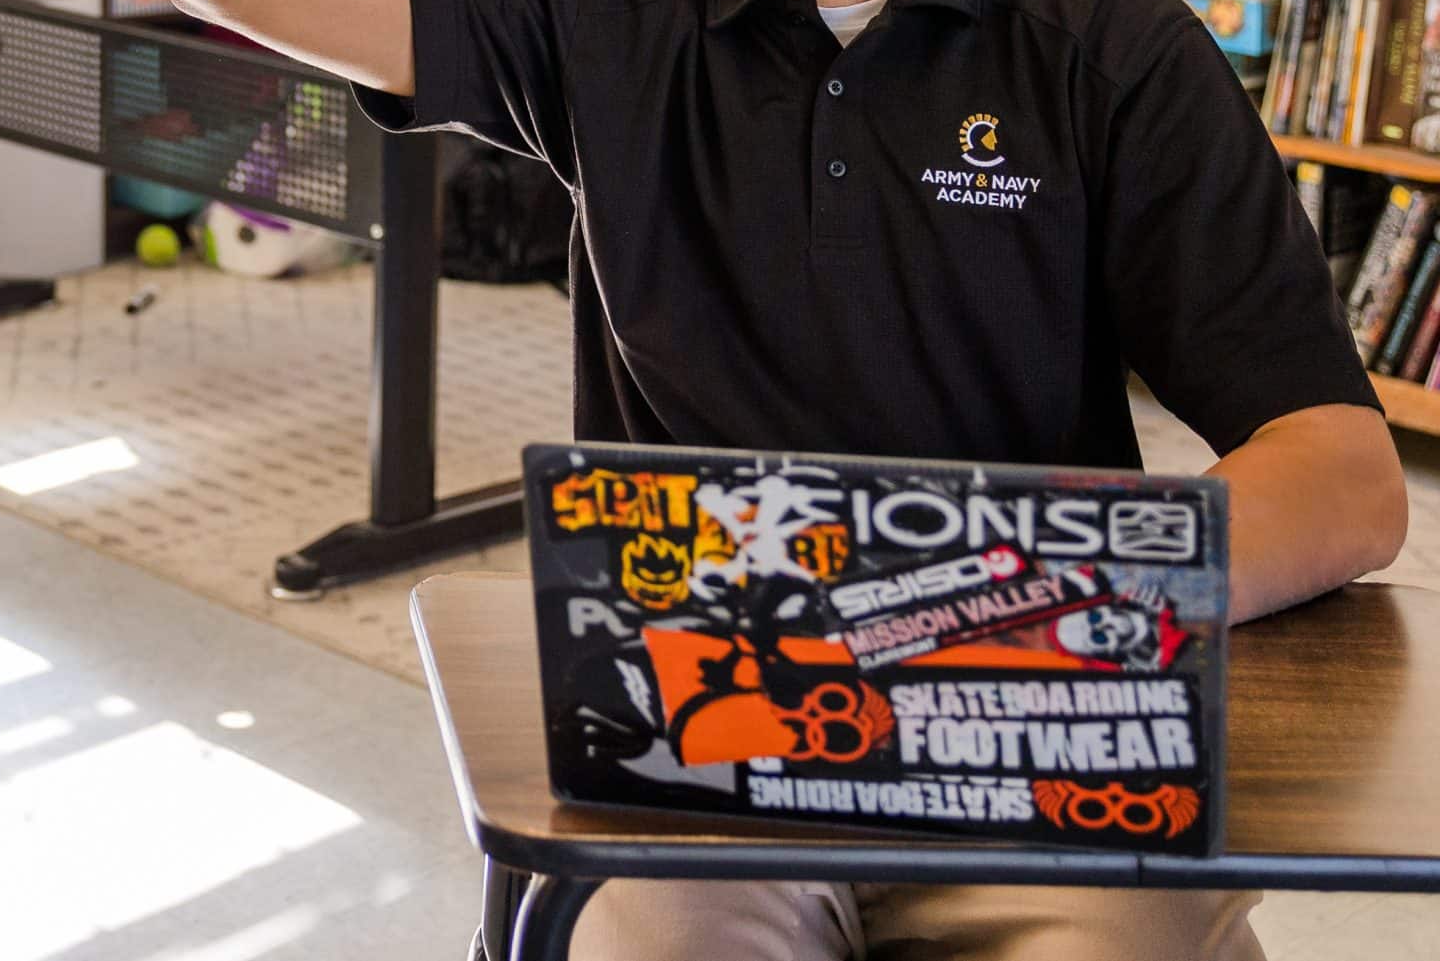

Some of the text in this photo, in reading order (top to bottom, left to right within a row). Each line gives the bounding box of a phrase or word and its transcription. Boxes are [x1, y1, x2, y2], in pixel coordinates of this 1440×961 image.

[921, 169, 1041, 193] ARMY & NAVY
[936, 187, 1027, 209] ACADEMY
[843, 574, 1066, 656] MISSION VALLEY
[889, 679, 1191, 718] SKATEBOARDING
[897, 716, 1197, 773] FOOTWEAR
[747, 774, 1036, 822] SKATEBOARDING
